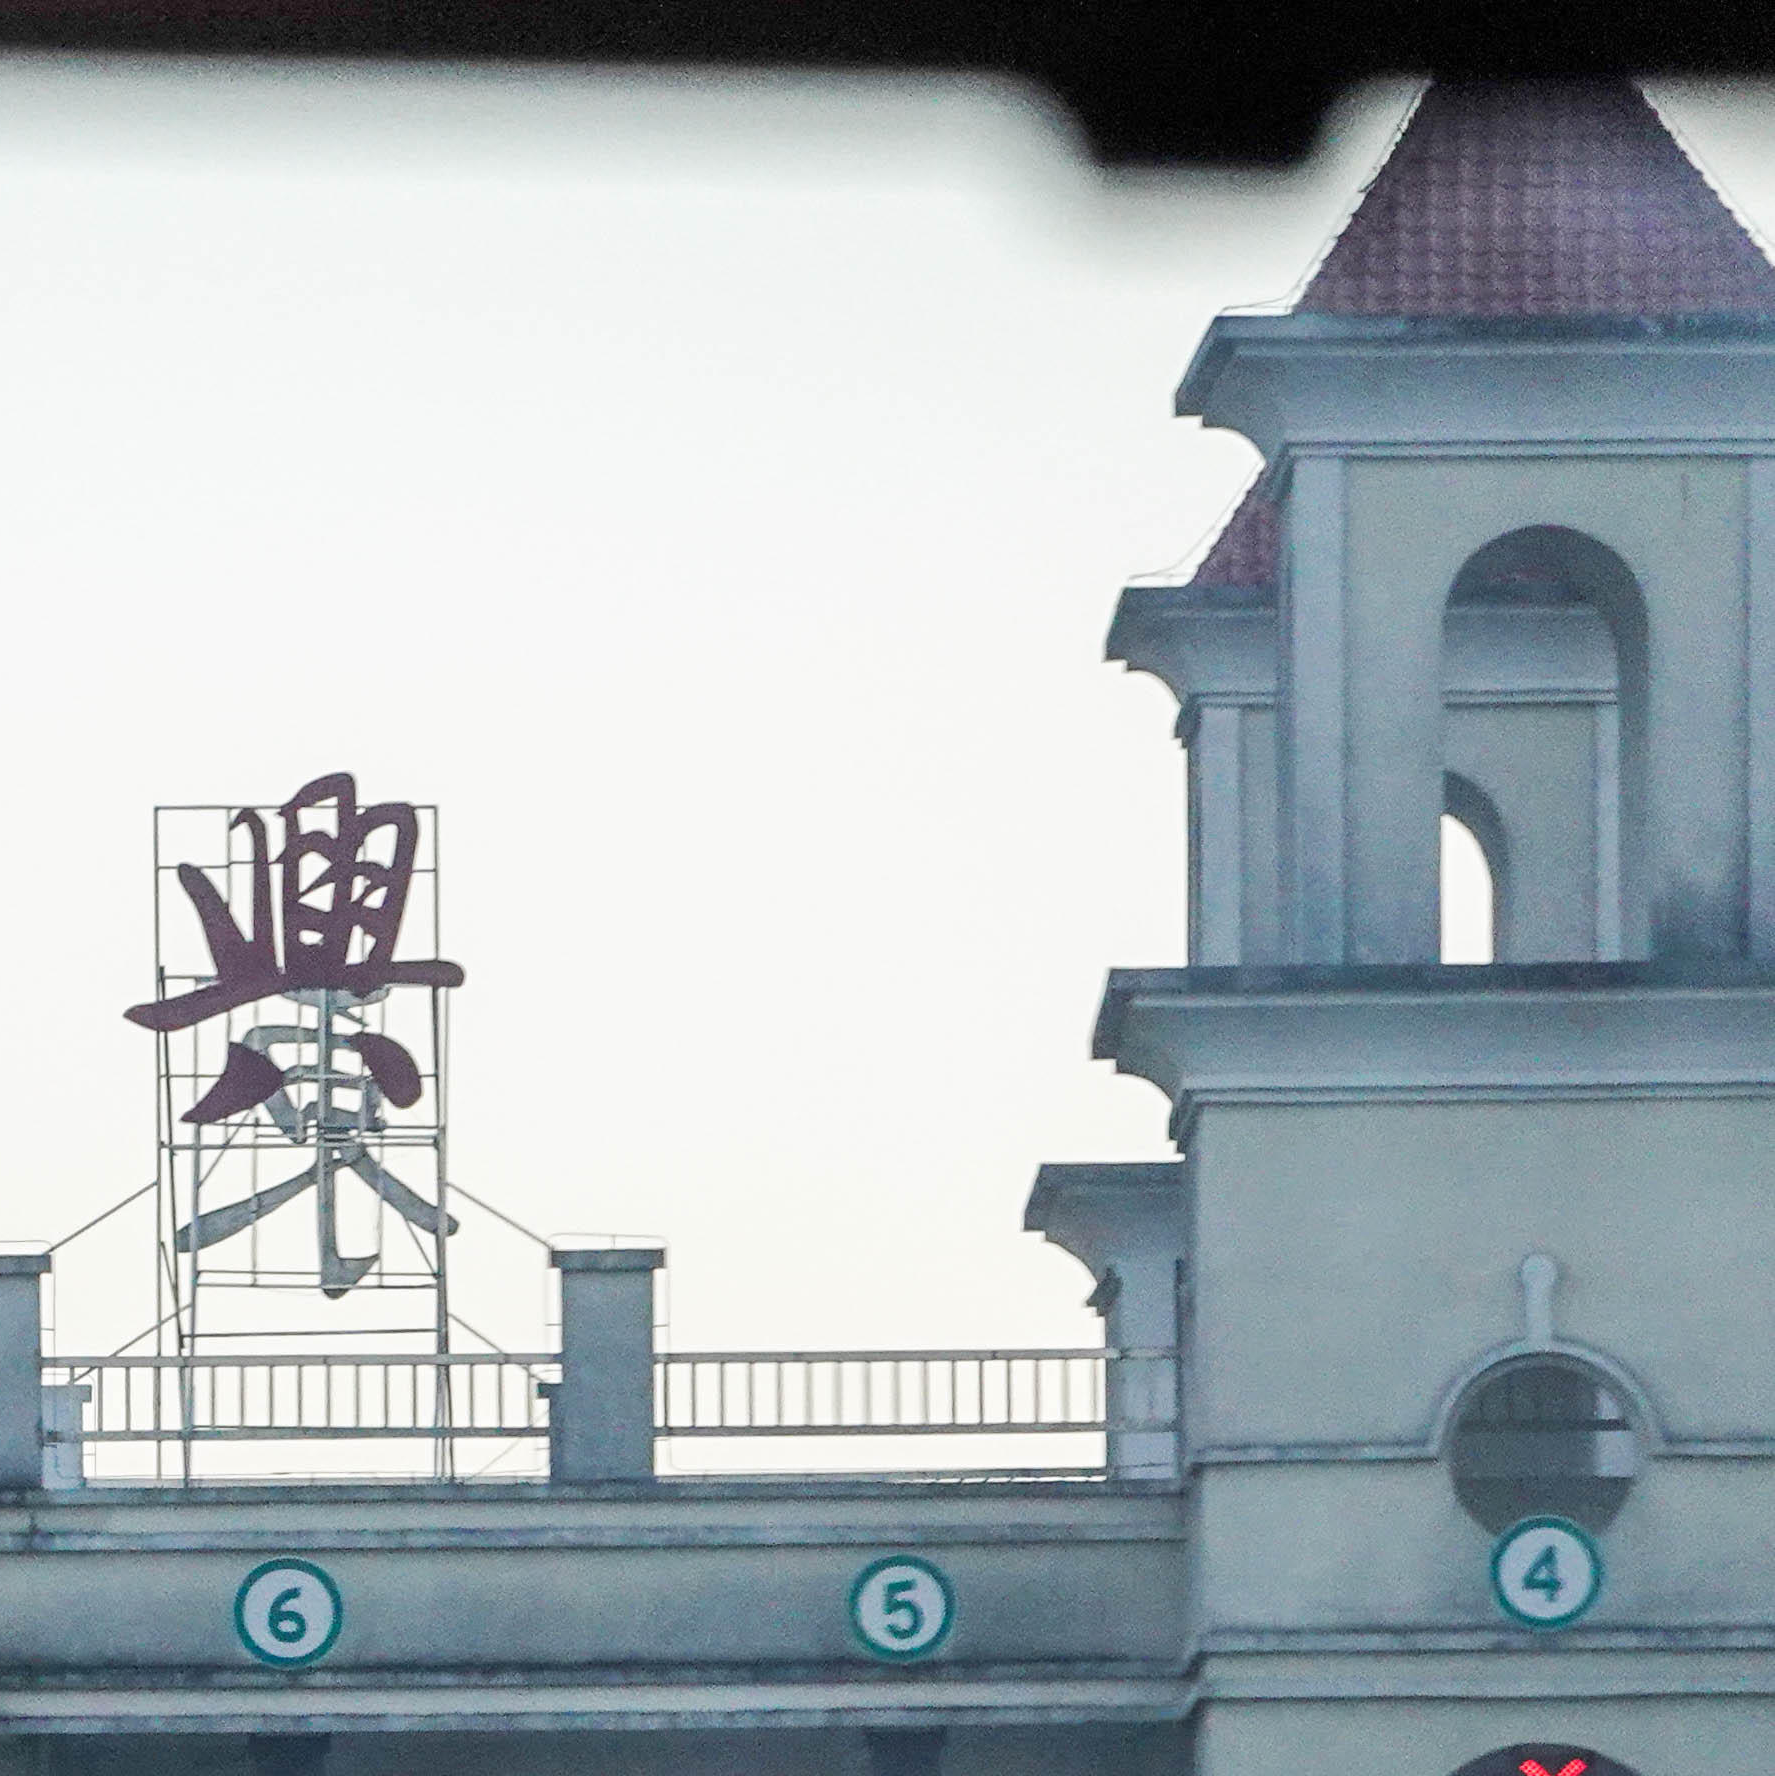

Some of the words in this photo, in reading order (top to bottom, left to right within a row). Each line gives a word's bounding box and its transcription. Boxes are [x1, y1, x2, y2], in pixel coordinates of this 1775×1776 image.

[1522, 1546, 1562, 1602] 4
[268, 1588, 306, 1643] 6
[884, 1580, 923, 1640] 5
